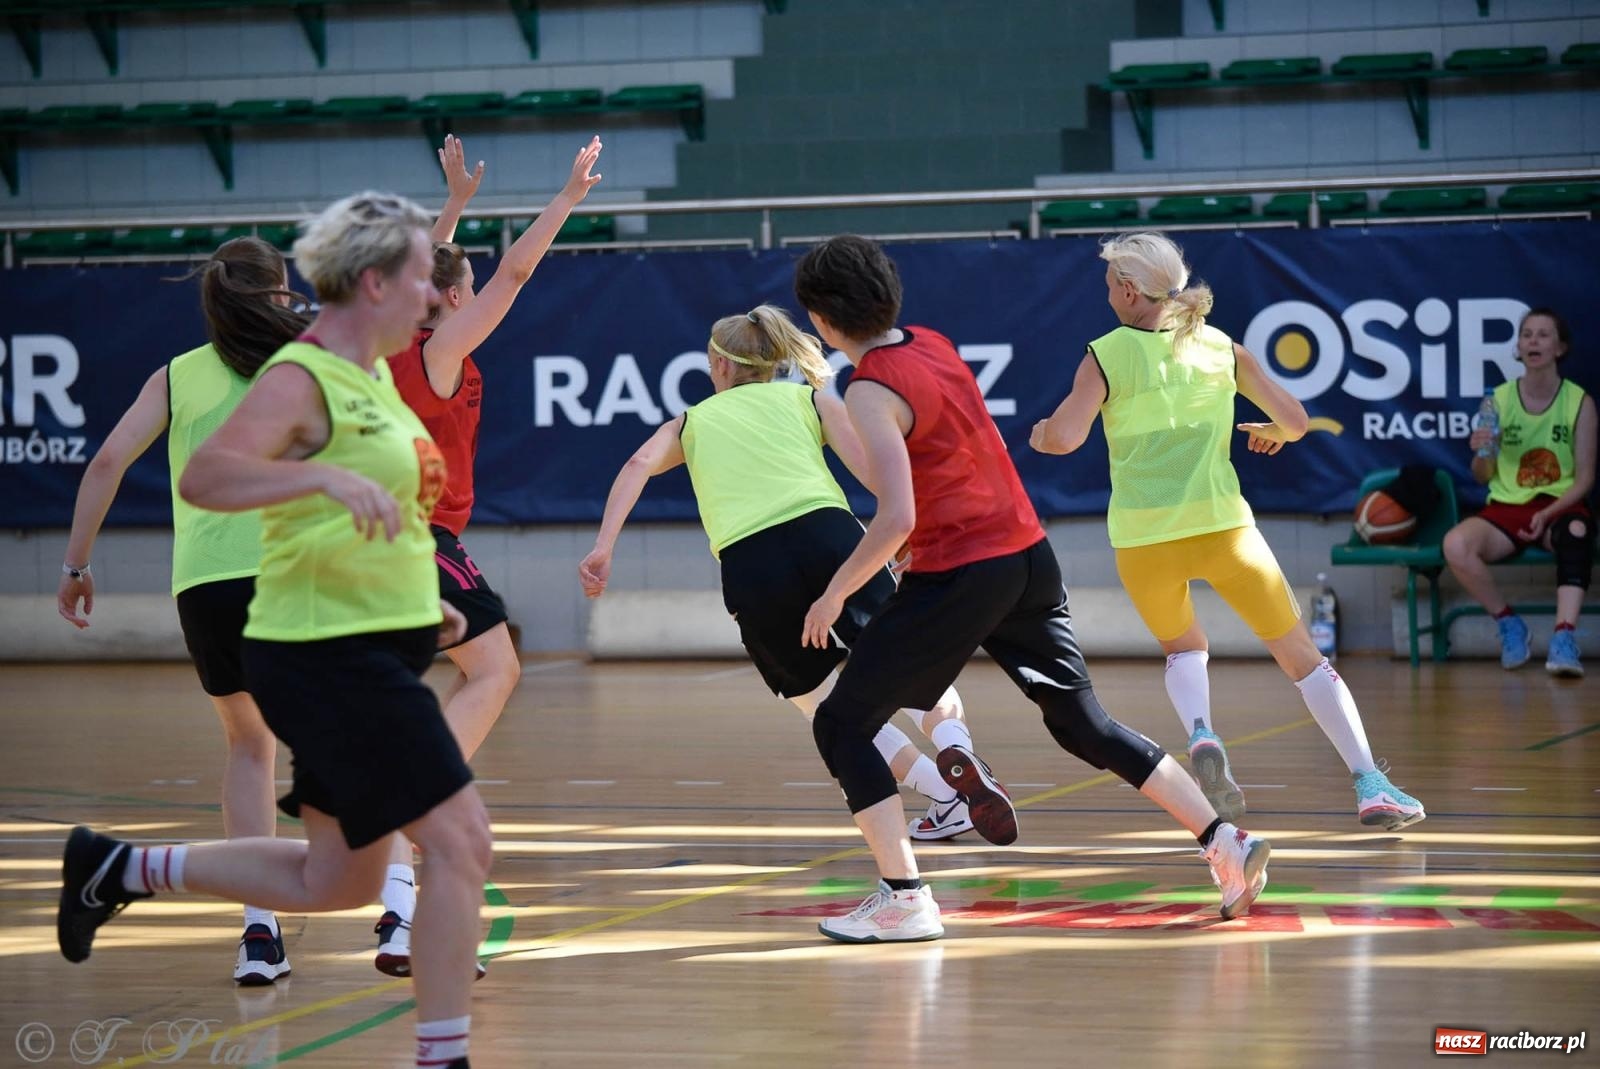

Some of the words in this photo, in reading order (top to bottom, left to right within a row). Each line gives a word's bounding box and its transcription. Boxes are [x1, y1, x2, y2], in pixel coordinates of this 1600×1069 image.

[0, 334, 86, 428] R
[1243, 298, 1530, 400] OSiR
[1363, 411, 1482, 440] RACIB
